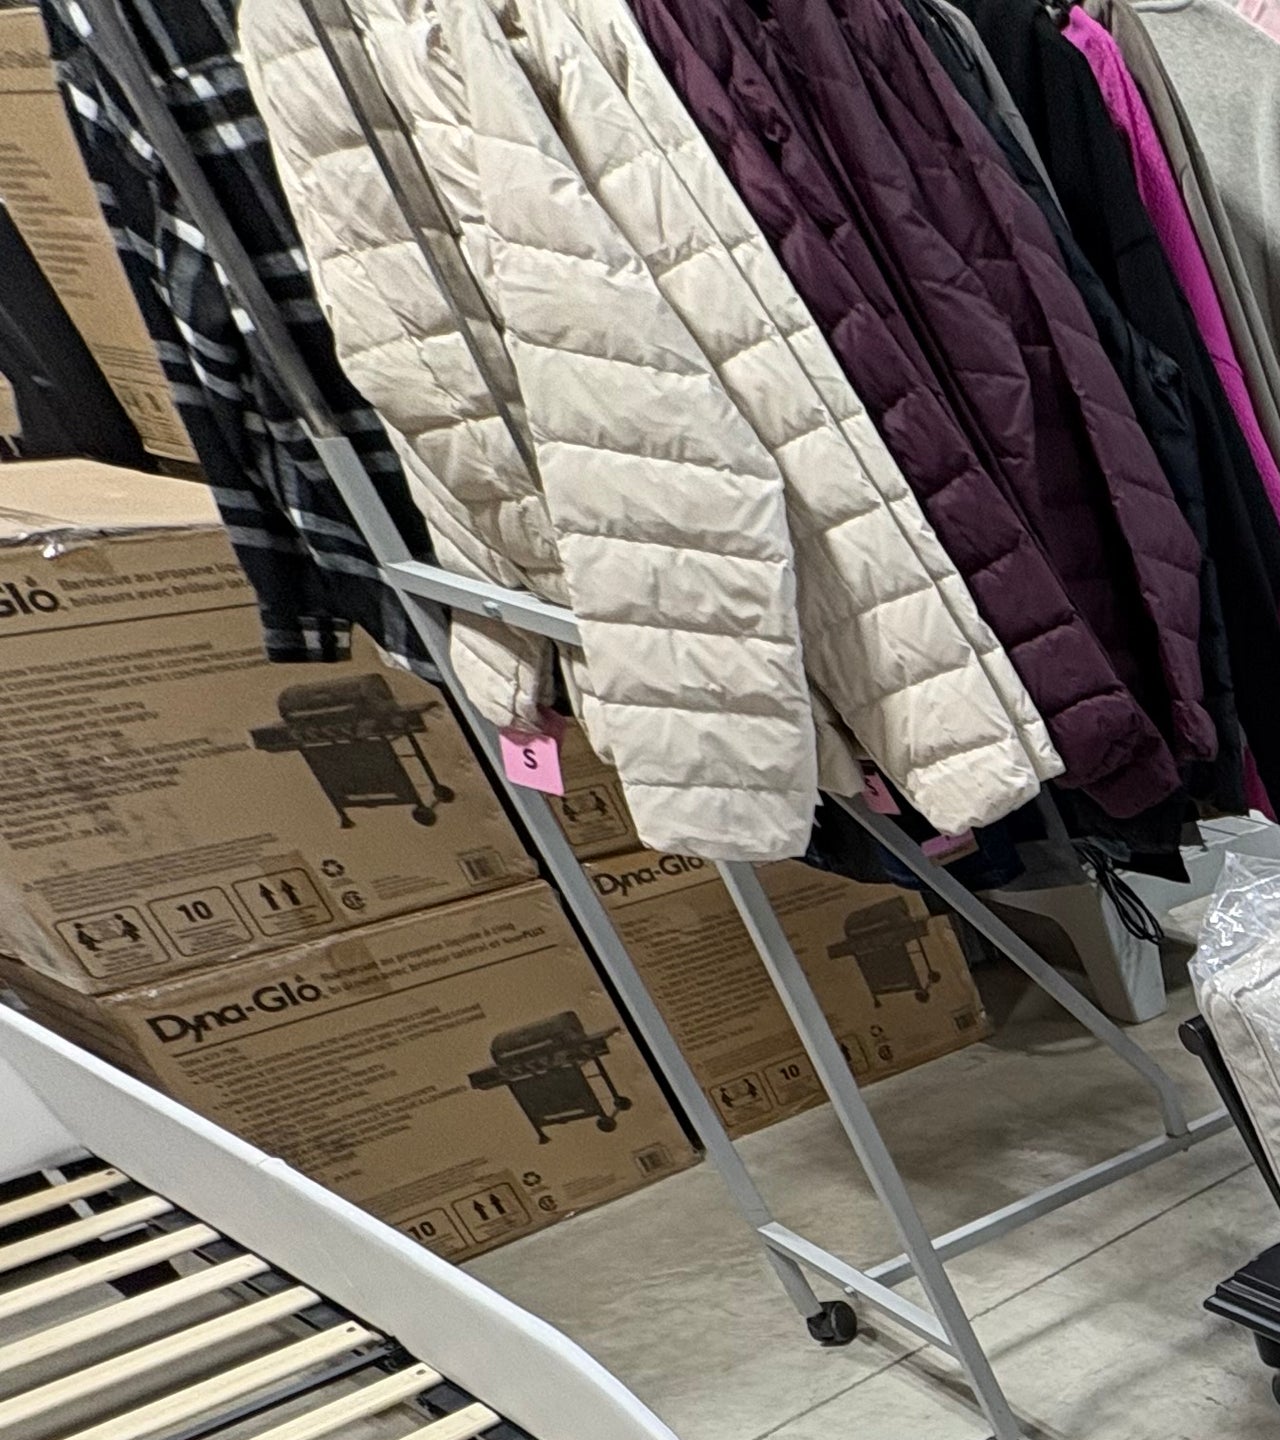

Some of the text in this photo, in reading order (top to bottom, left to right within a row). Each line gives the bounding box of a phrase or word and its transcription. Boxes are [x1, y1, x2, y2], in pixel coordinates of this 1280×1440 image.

[521, 748, 539, 771] S
[176, 901, 215, 924] 10
[779, 1064, 801, 1082] 10
[407, 1220, 438, 1243] 10
